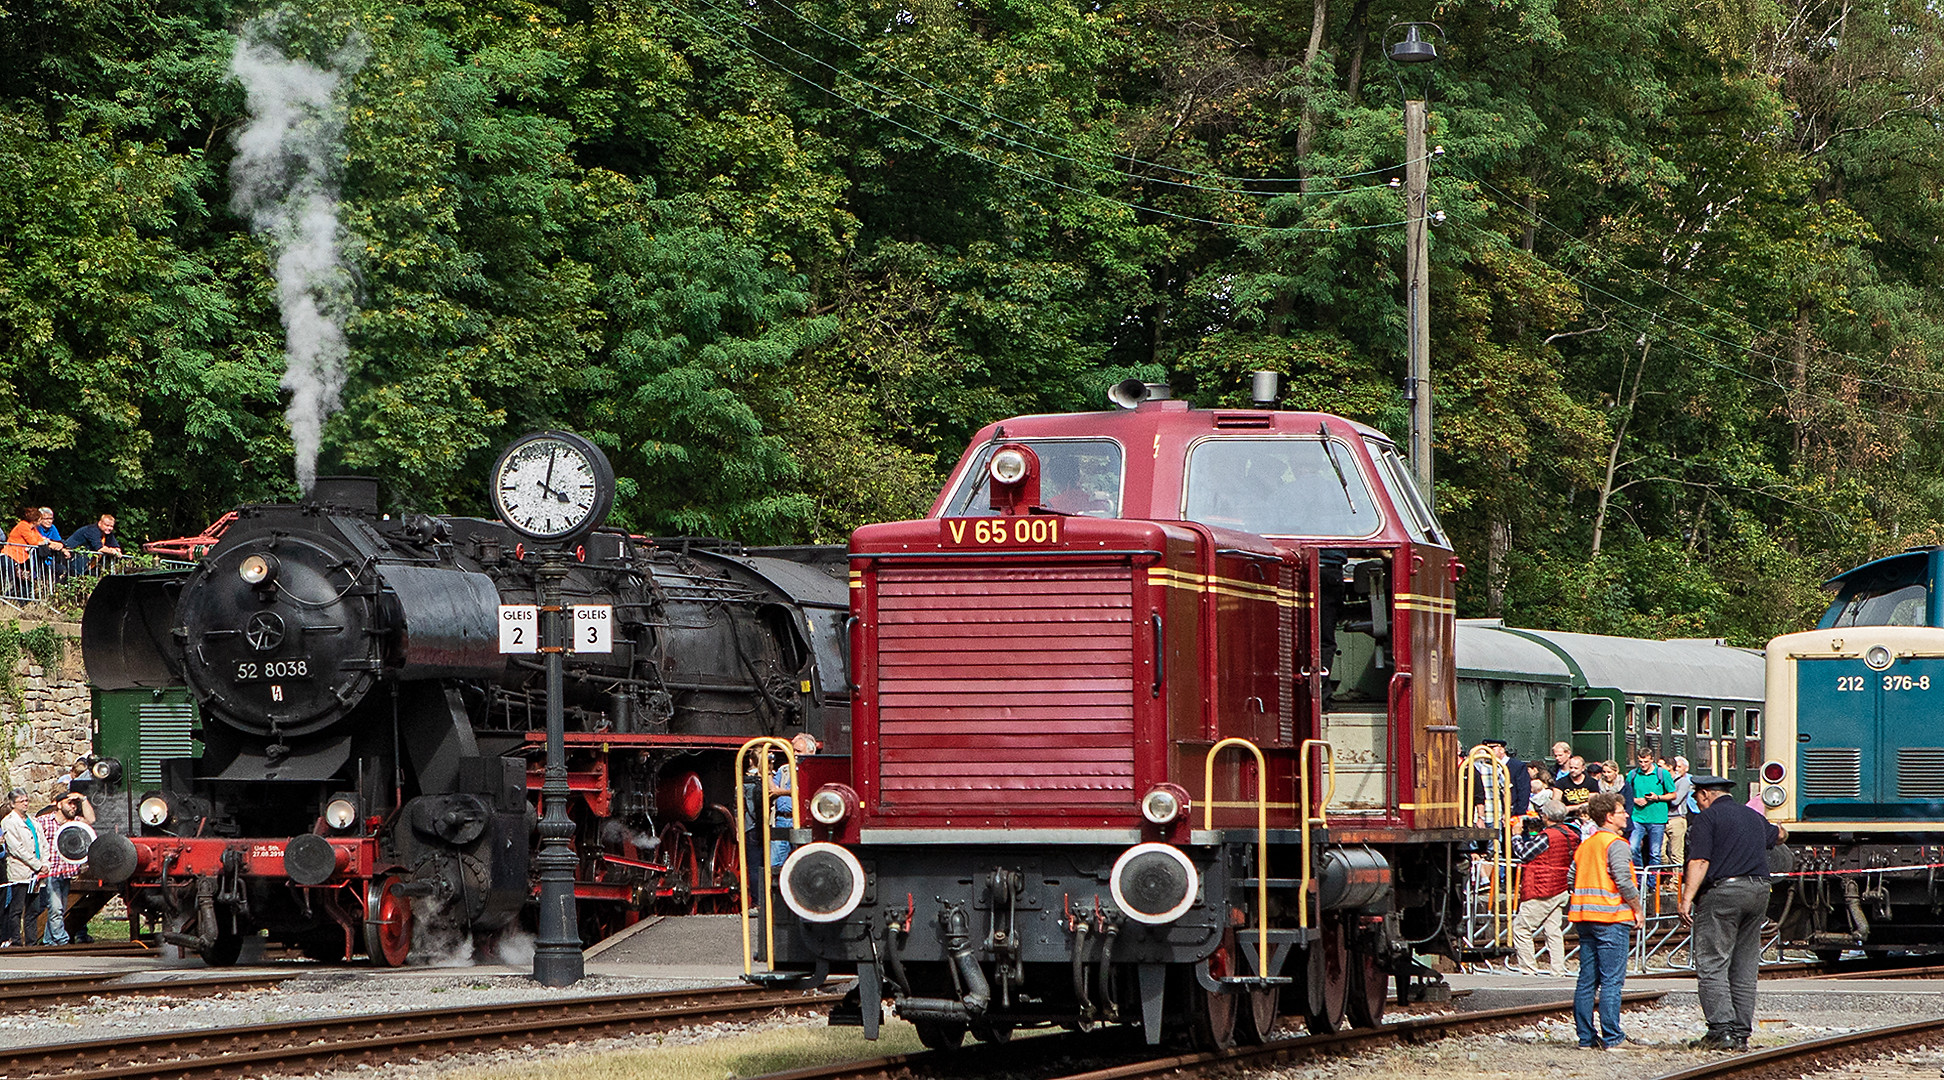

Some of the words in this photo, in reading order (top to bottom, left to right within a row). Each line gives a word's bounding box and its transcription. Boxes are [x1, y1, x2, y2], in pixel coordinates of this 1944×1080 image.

[948, 520, 966, 544] V
[975, 519, 1007, 544] 65
[1014, 519, 1057, 543] 001
[503, 610, 532, 620] GLEIS
[577, 609, 607, 620] GLEIS
[513, 626, 523, 644] 2
[587, 626, 598, 643] 3
[237, 662, 258, 679] 52
[265, 660, 307, 677] 8038
[1837, 675, 1864, 691] 212
[1882, 675, 1930, 691] 376-8
